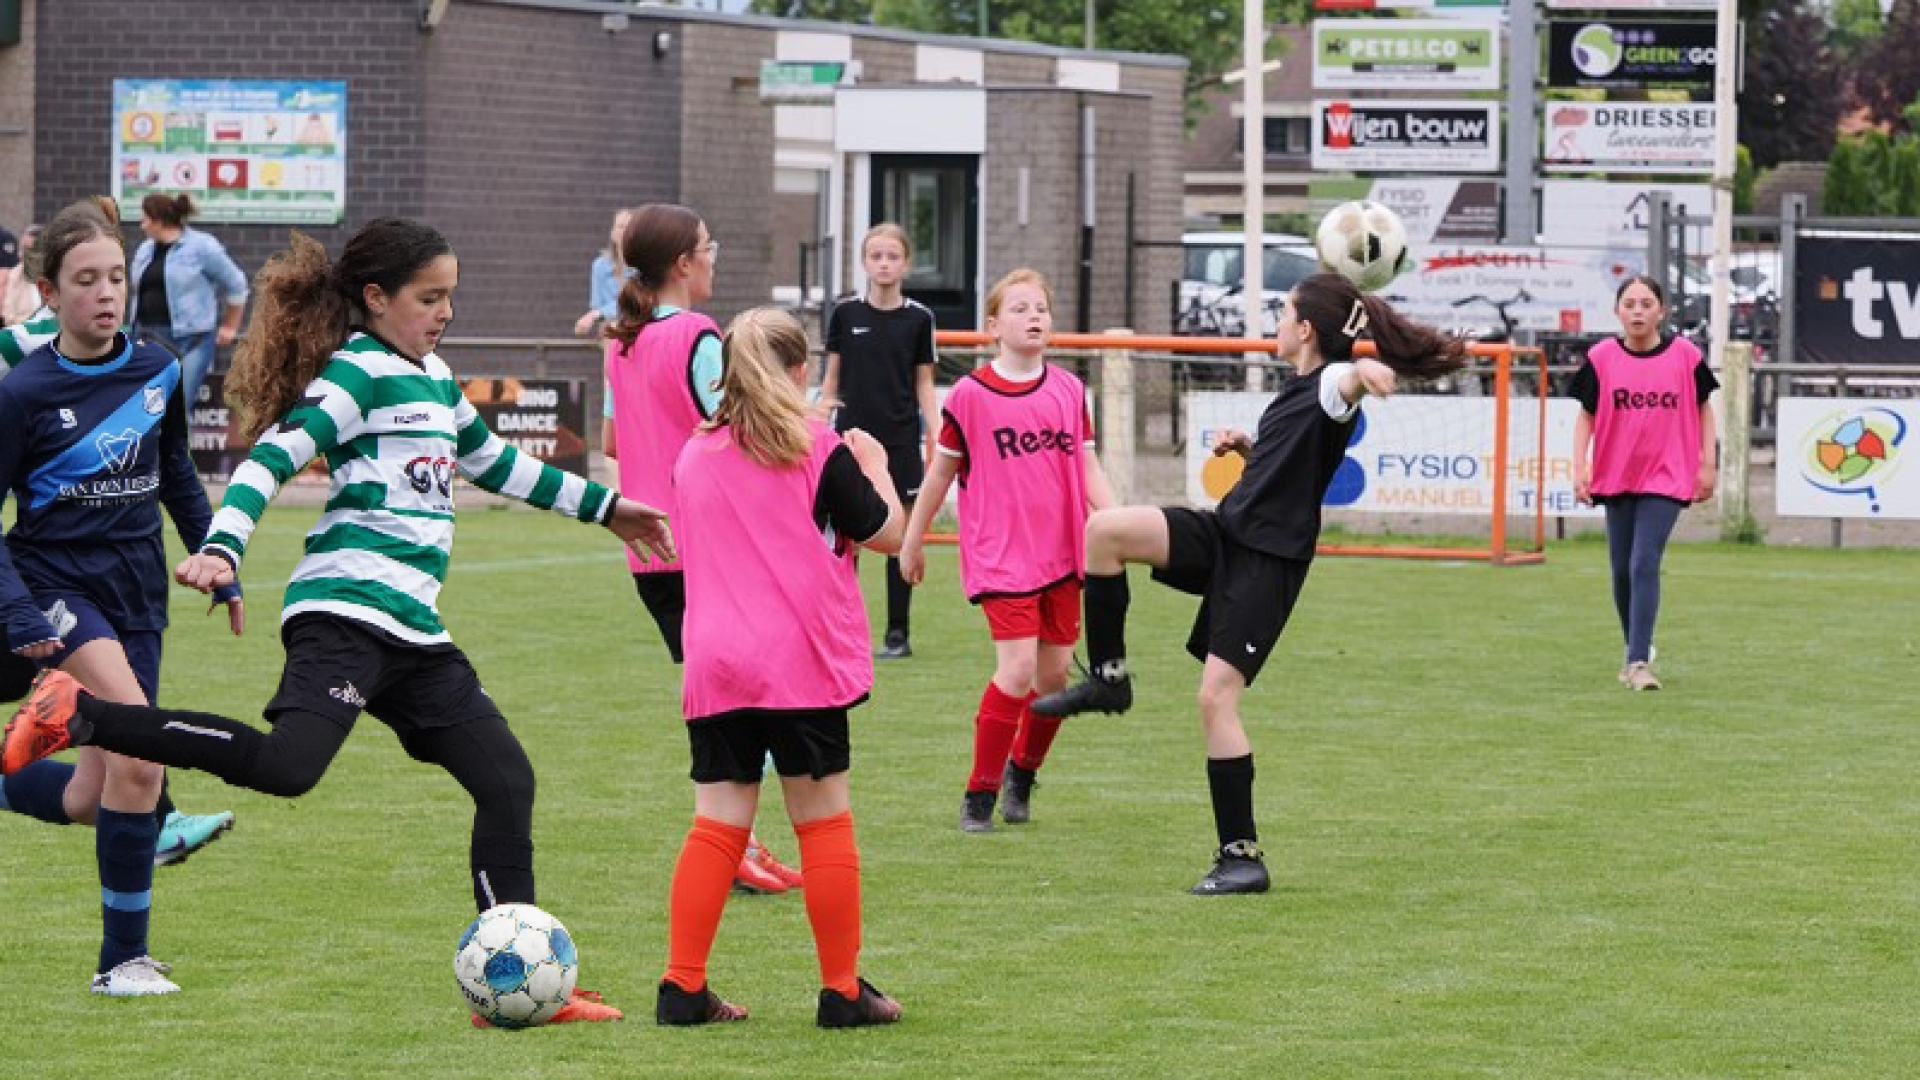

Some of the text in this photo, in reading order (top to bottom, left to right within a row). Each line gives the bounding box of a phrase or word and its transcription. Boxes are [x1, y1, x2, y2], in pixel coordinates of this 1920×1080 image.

[1350, 38, 1459, 59] PETS&CO
[1326, 110, 1485, 143] Wijen bouw
[497, 411, 558, 432] DANCE
[1377, 454, 1572, 482] FYSIOTHER
[1377, 487, 1483, 507] MANUEL
